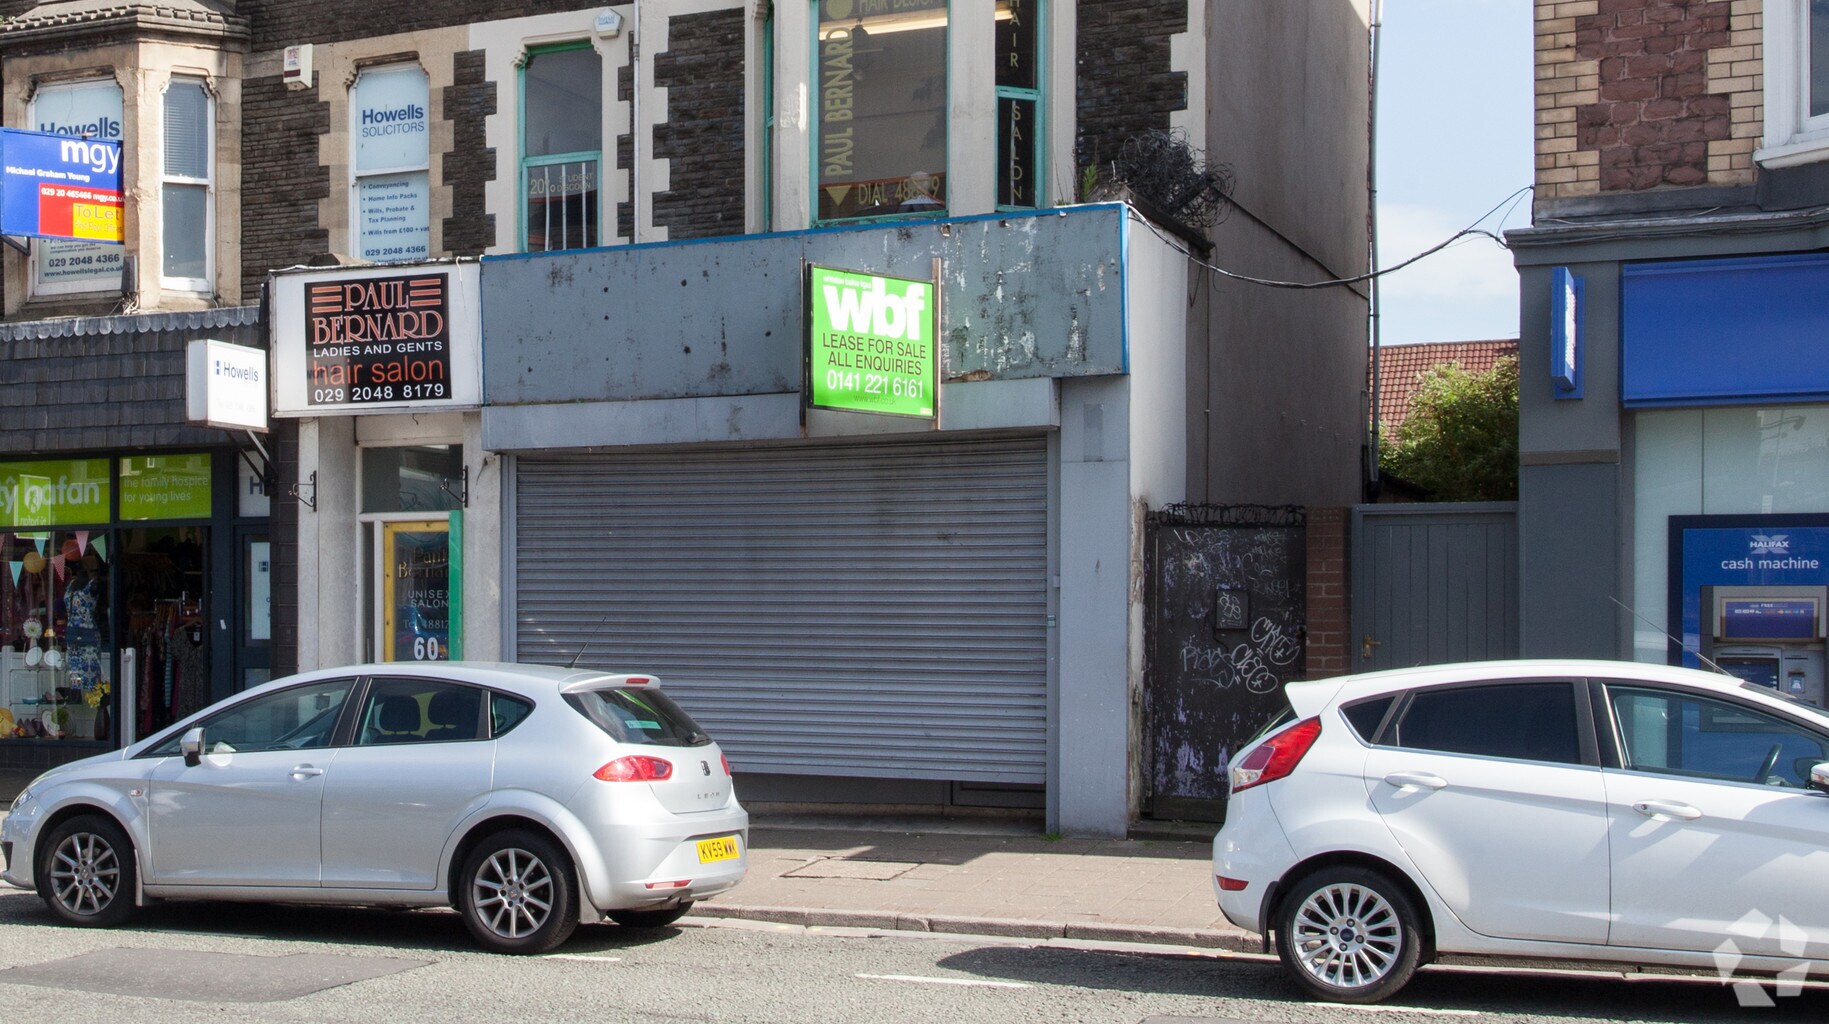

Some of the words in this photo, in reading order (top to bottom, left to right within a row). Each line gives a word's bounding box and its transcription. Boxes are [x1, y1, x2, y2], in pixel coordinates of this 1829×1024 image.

[824, 27, 853, 123] BERNARD
[362, 104, 425, 125] Howells
[362, 121, 425, 138] SOLICITORS
[61, 140, 121, 174] mgy
[824, 127, 853, 177] PAUL
[6, 166, 35, 176] Michael
[36, 169, 66, 180] Graham
[67, 172, 91, 183] Young
[41, 187, 55, 196] 029
[56, 189, 65, 197] 20
[368, 181, 409, 190] Conveyancing
[858, 182, 888, 206] DIAL
[76, 204, 91, 218] To
[95, 207, 119, 221] Let
[385, 205, 409, 213] Probate
[48, 258, 67, 267] 029
[69, 256, 93, 265] 2048
[95, 253, 120, 263] 4366
[365, 249, 381, 257] 029
[382, 246, 403, 255] 2048
[405, 245, 426, 254] 4366
[344, 280, 409, 312] PAUL
[823, 276, 925, 341] wbf
[312, 310, 444, 345] BERNARD
[313, 345, 360, 358] LADIES
[364, 343, 392, 355] AND
[396, 341, 443, 354] GENTS
[822, 332, 865, 352] LEASE
[868, 338, 894, 356] FOR
[897, 341, 927, 360] SALE
[223, 361, 259, 382] Howells
[313, 359, 363, 386] hair
[371, 354, 444, 383] salon
[828, 351, 852, 368] ALL
[855, 354, 922, 376] ENQUIRIES
[314, 388, 345, 403] 029
[352, 386, 394, 401] 2048
[402, 383, 444, 398] 8179
[826, 369, 861, 392] 0141
[864, 373, 889, 395] 221
[892, 377, 923, 399] 6161
[124, 477, 138, 488] the
[142, 477, 169, 489] family
[172, 476, 208, 488] hospice
[124, 491, 136, 503] for
[139, 492, 168, 504] young
[170, 491, 192, 501] lives
[1721, 557, 1754, 570] cash
[1758, 557, 1819, 570] machine
[414, 636, 439, 660] 60
